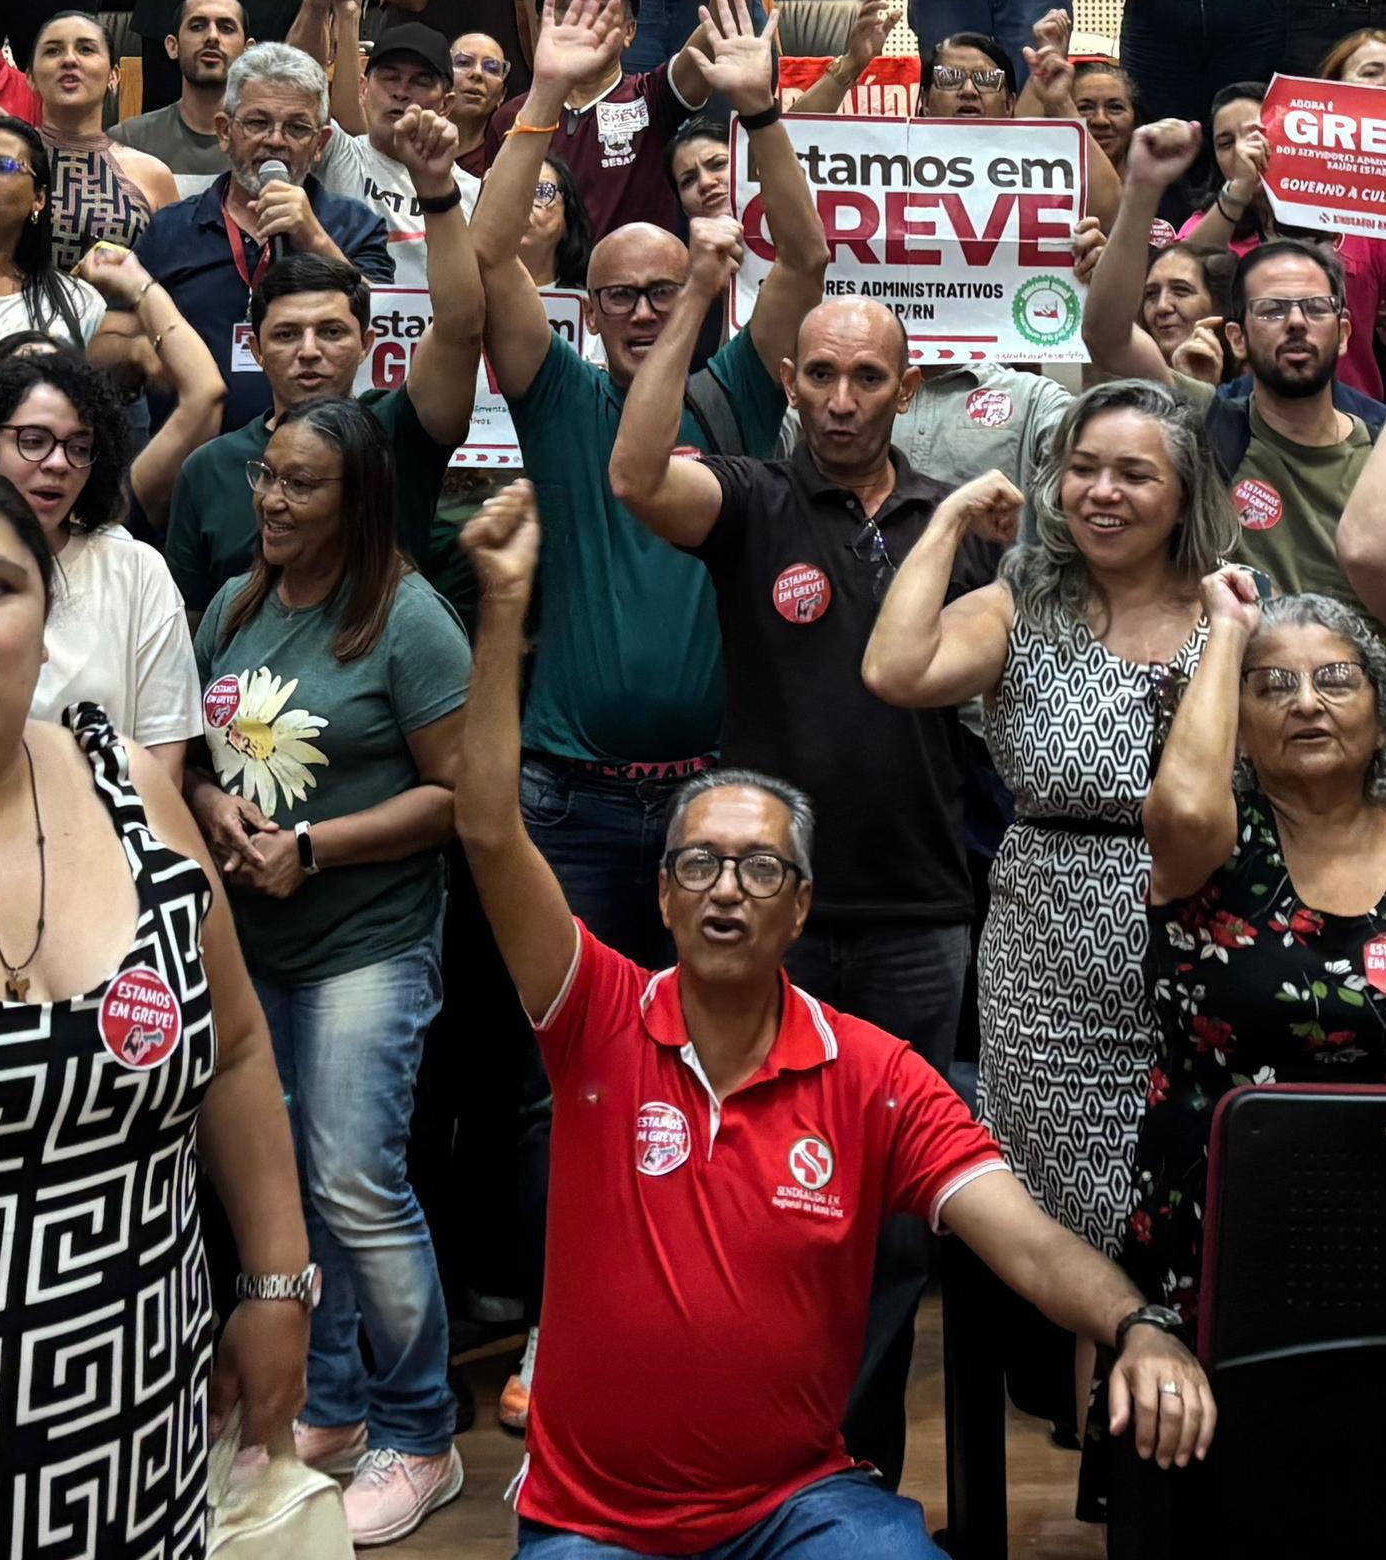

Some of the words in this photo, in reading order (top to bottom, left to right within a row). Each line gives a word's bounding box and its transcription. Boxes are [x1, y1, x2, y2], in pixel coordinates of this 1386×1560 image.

[1290, 99, 1325, 111] AGORA
[1327, 100, 1334, 112] É
[601, 153, 636, 168] SESAP
[1276, 144, 1296, 157] DOS
[747, 145, 974, 189] tamos
[987, 156, 1074, 190] em
[1280, 177, 1346, 198] GOVERNO
[1348, 186, 1358, 200] A
[410, 197, 421, 218] D
[860, 280, 1004, 300] ADMINISTRATIVOS
[779, 568, 820, 590] ESTAMOS
[779, 590, 793, 603] EM
[1367, 957, 1386, 970] EM
[117, 981, 171, 1009] ESTAMOS
[108, 1000, 129, 1019] EM
[131, 1005, 174, 1030] GREVE!
[637, 1131, 648, 1142] M
